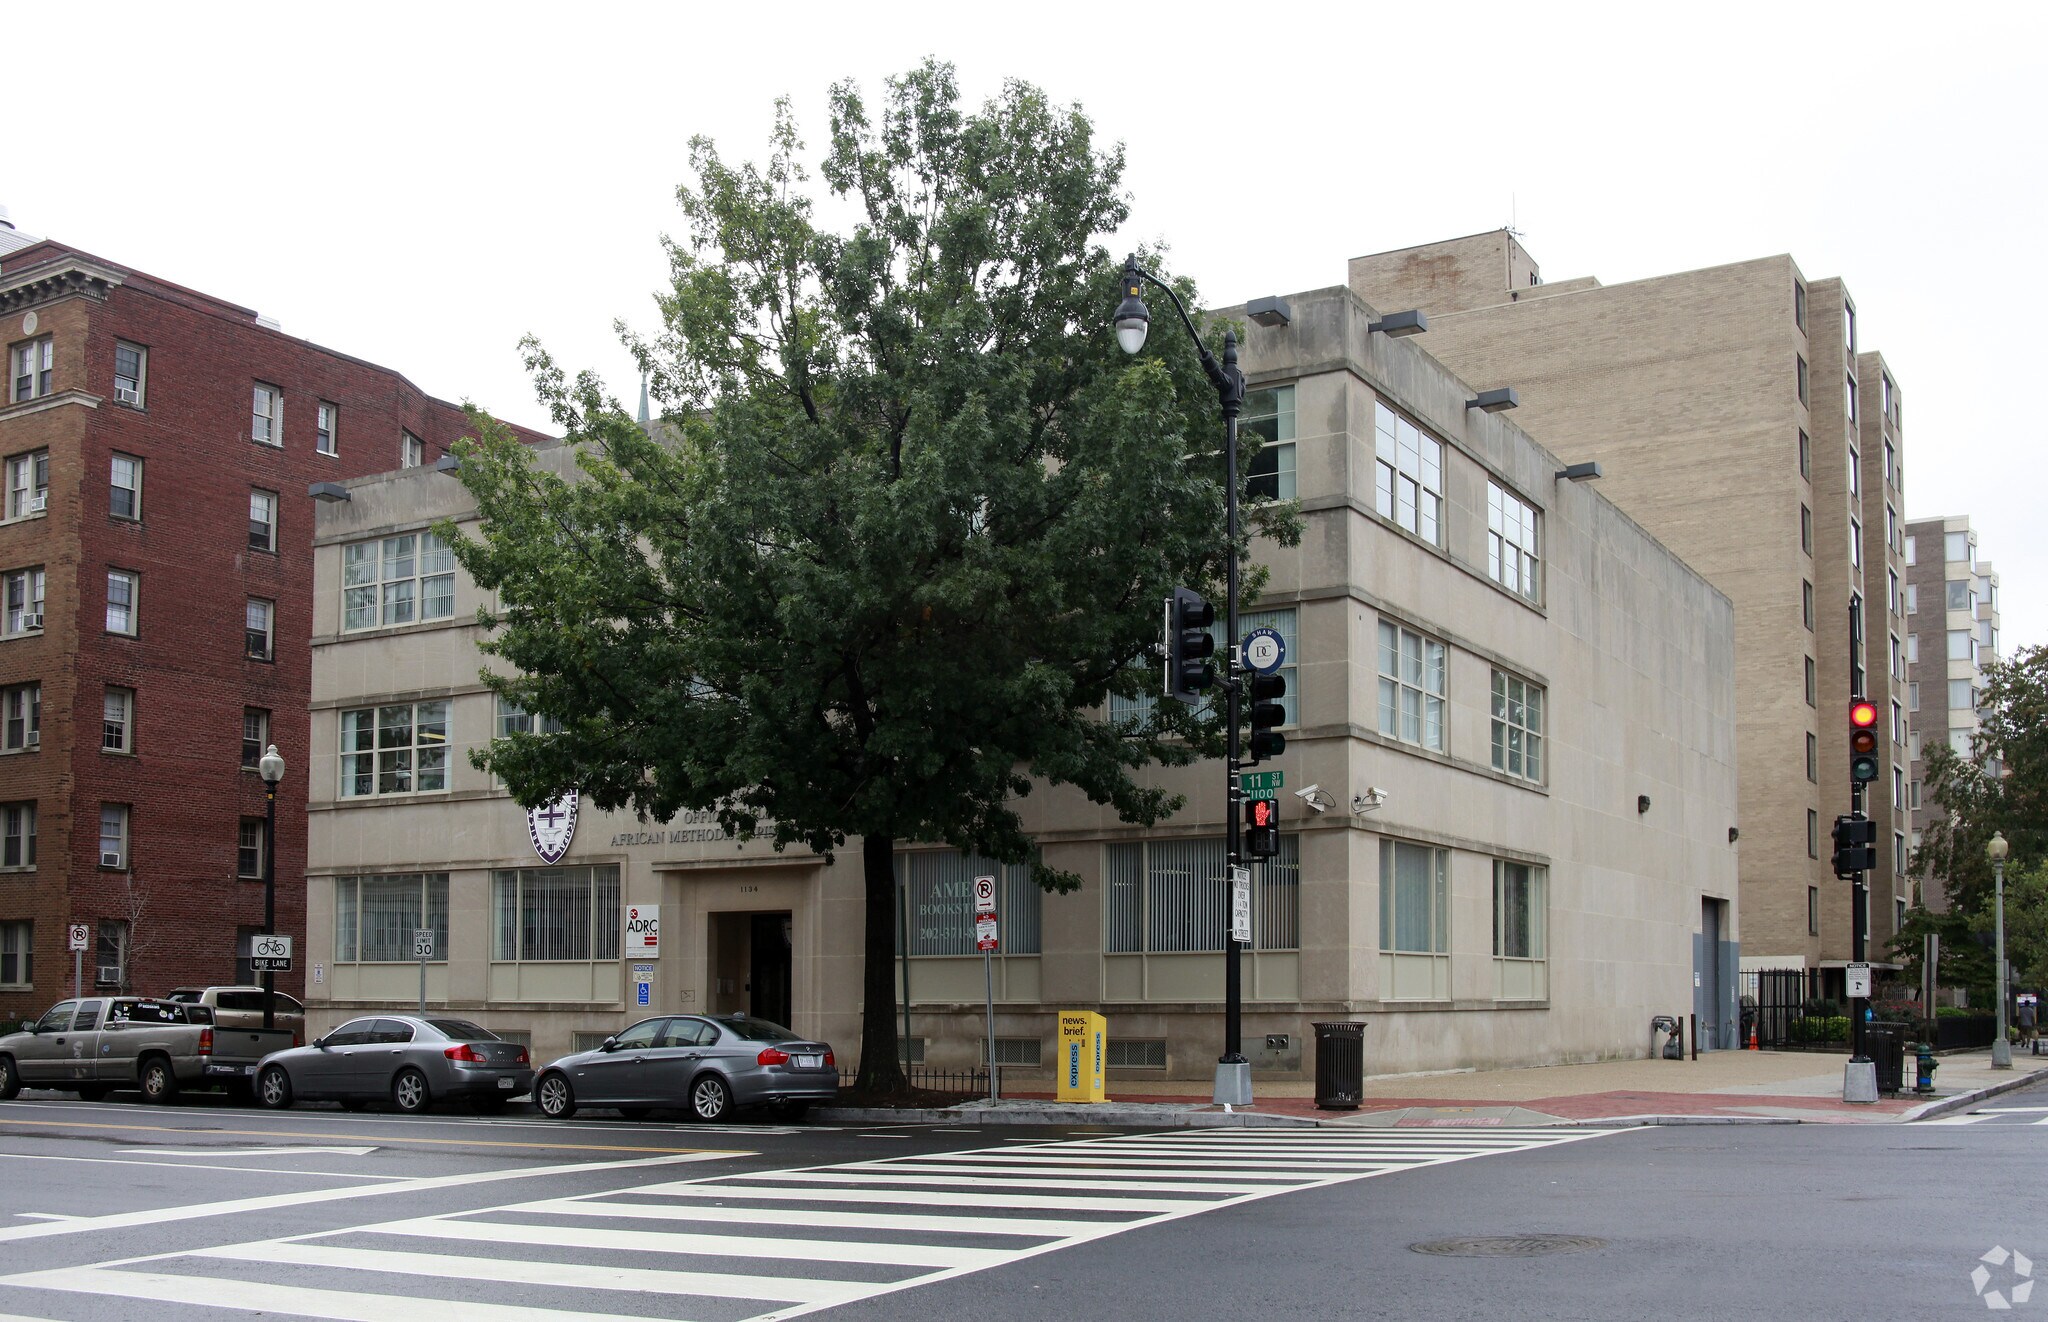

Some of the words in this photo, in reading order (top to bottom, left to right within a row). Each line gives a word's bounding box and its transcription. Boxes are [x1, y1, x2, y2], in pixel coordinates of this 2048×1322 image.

[1252, 630, 1274, 638] SHAW
[1256, 645, 1271, 657] DC
[1249, 774, 1261, 788] 11
[1271, 772, 1280, 780] ST
[1250, 788, 1274, 799] 1100
[611, 831, 665, 846] AFRICAN
[627, 920, 658, 932] ADRC
[416, 944, 432, 955] 30
[1062, 1017, 1087, 1025] news.
[1064, 1026, 1085, 1036] brief.
